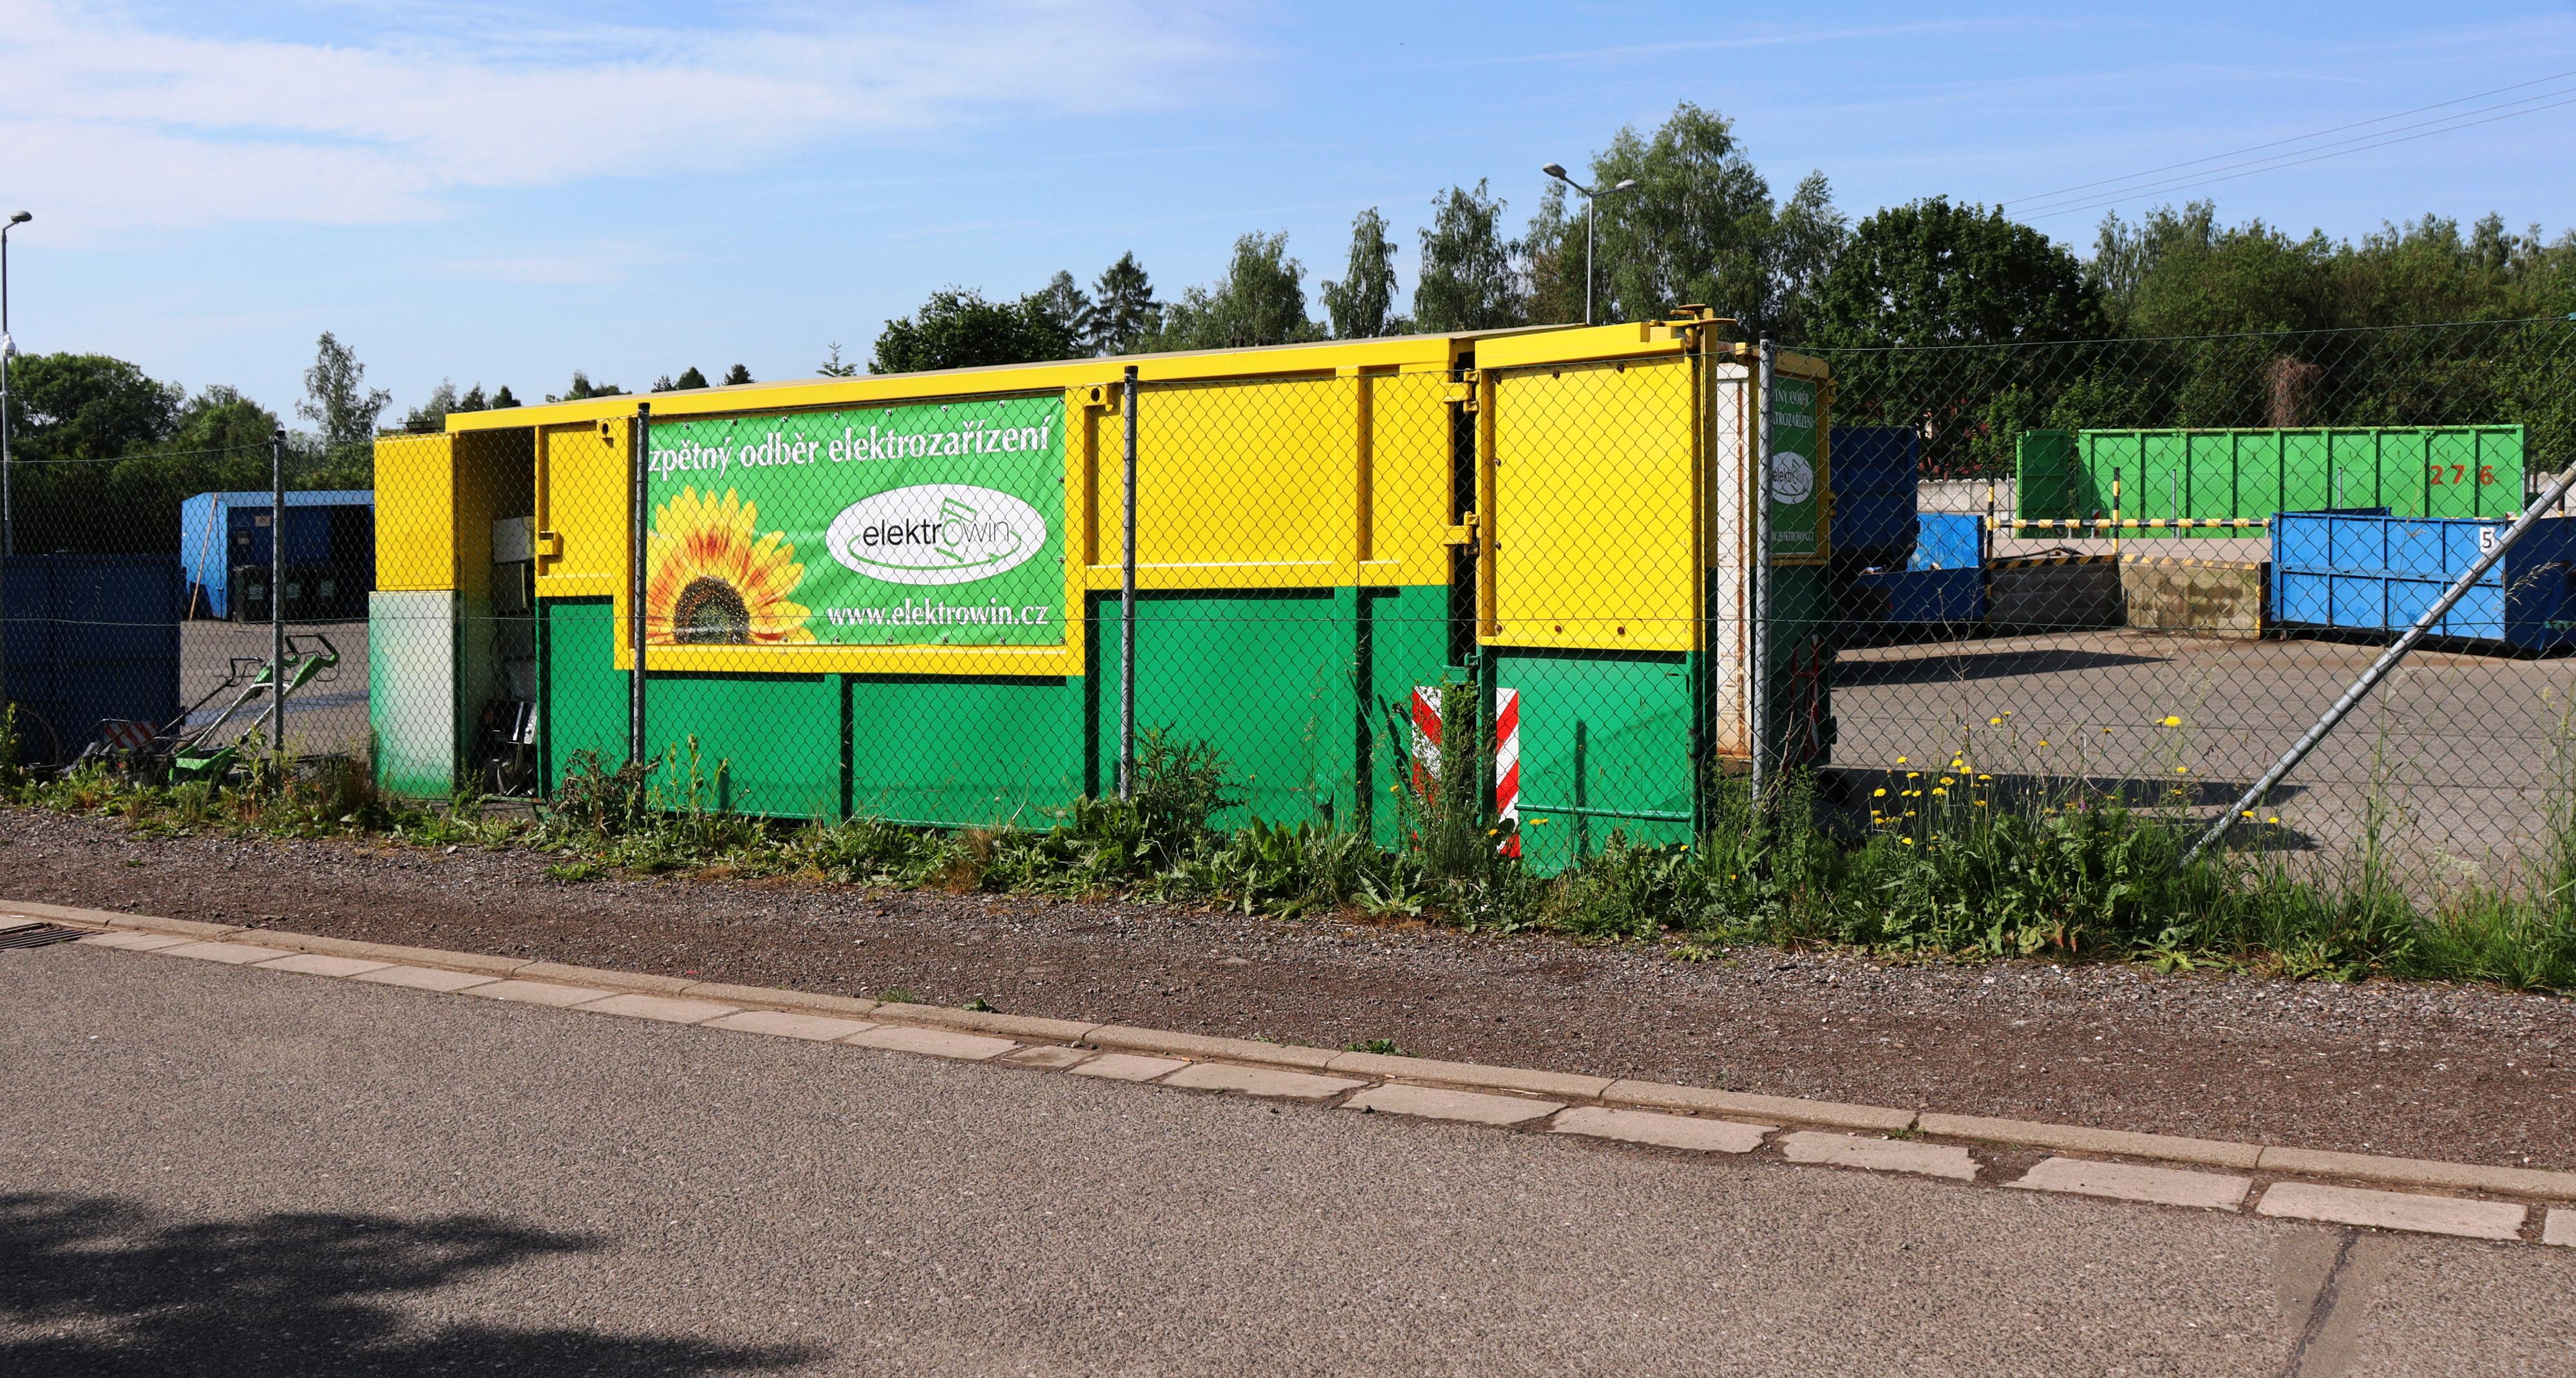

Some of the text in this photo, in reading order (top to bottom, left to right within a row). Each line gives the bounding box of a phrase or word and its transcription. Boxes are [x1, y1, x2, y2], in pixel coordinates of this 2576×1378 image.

[1774, 388, 1787, 402] TNÝ
[1774, 411, 1814, 428] TROZAŘÍZENÍ
[648, 415, 1051, 481] zpětný odběr elektrozařízení
[2483, 532, 2492, 548] 5
[827, 598, 1048, 625] www.elektrowin.cz
